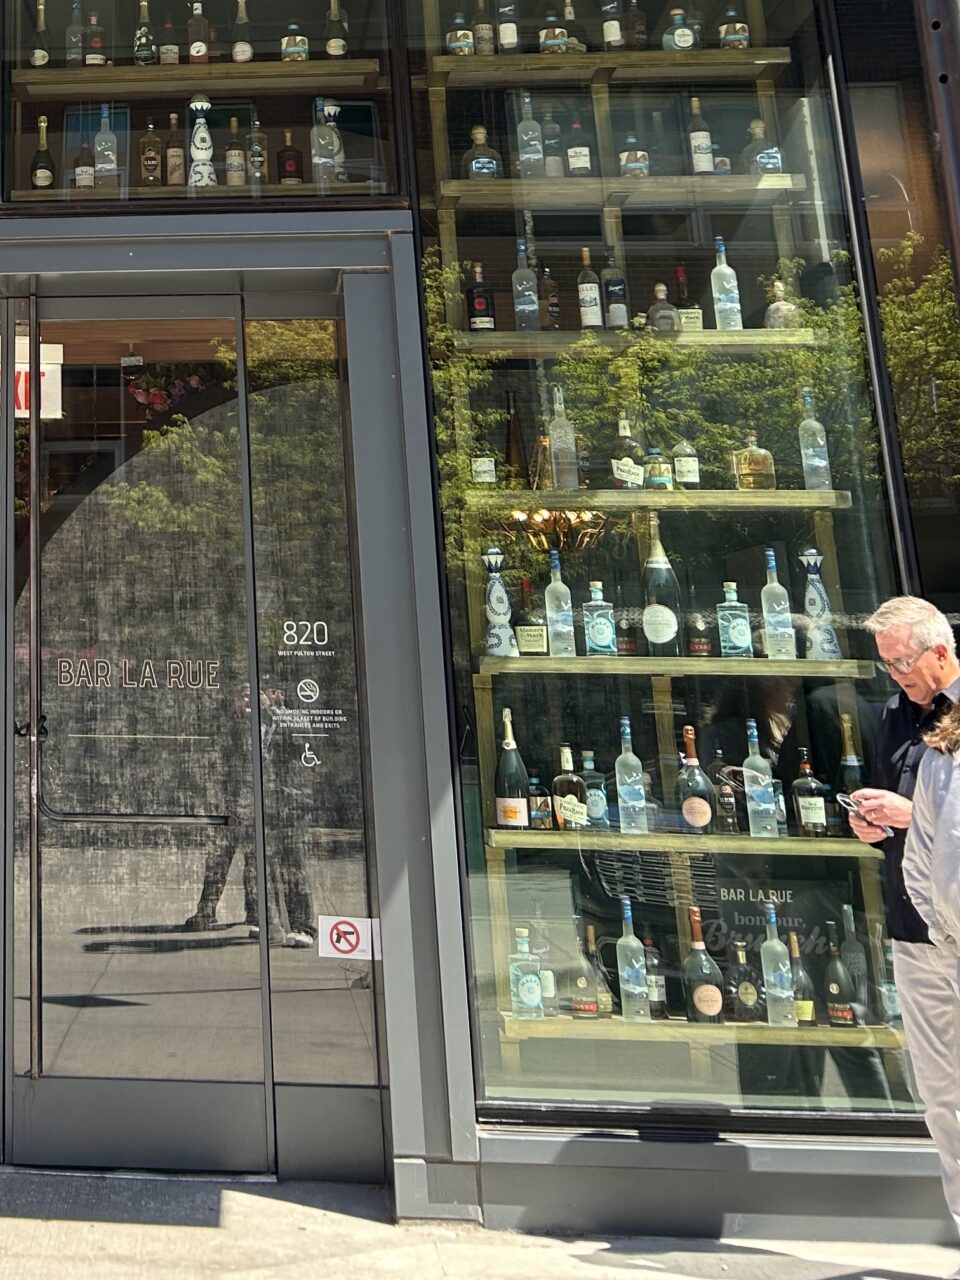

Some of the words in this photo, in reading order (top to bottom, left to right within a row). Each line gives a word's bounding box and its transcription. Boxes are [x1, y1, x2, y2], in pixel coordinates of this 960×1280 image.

[284, 621, 328, 644] 820
[57, 658, 112, 686] BAR
[122, 658, 158, 688] LA
[166, 660, 220, 688] RUE
[720, 888, 745, 900] BAR
[749, 889, 764, 902] LA
[768, 890, 793, 902] RUE
[734, 912, 806, 928] bonour,
[700, 918, 829, 956] Bruch
